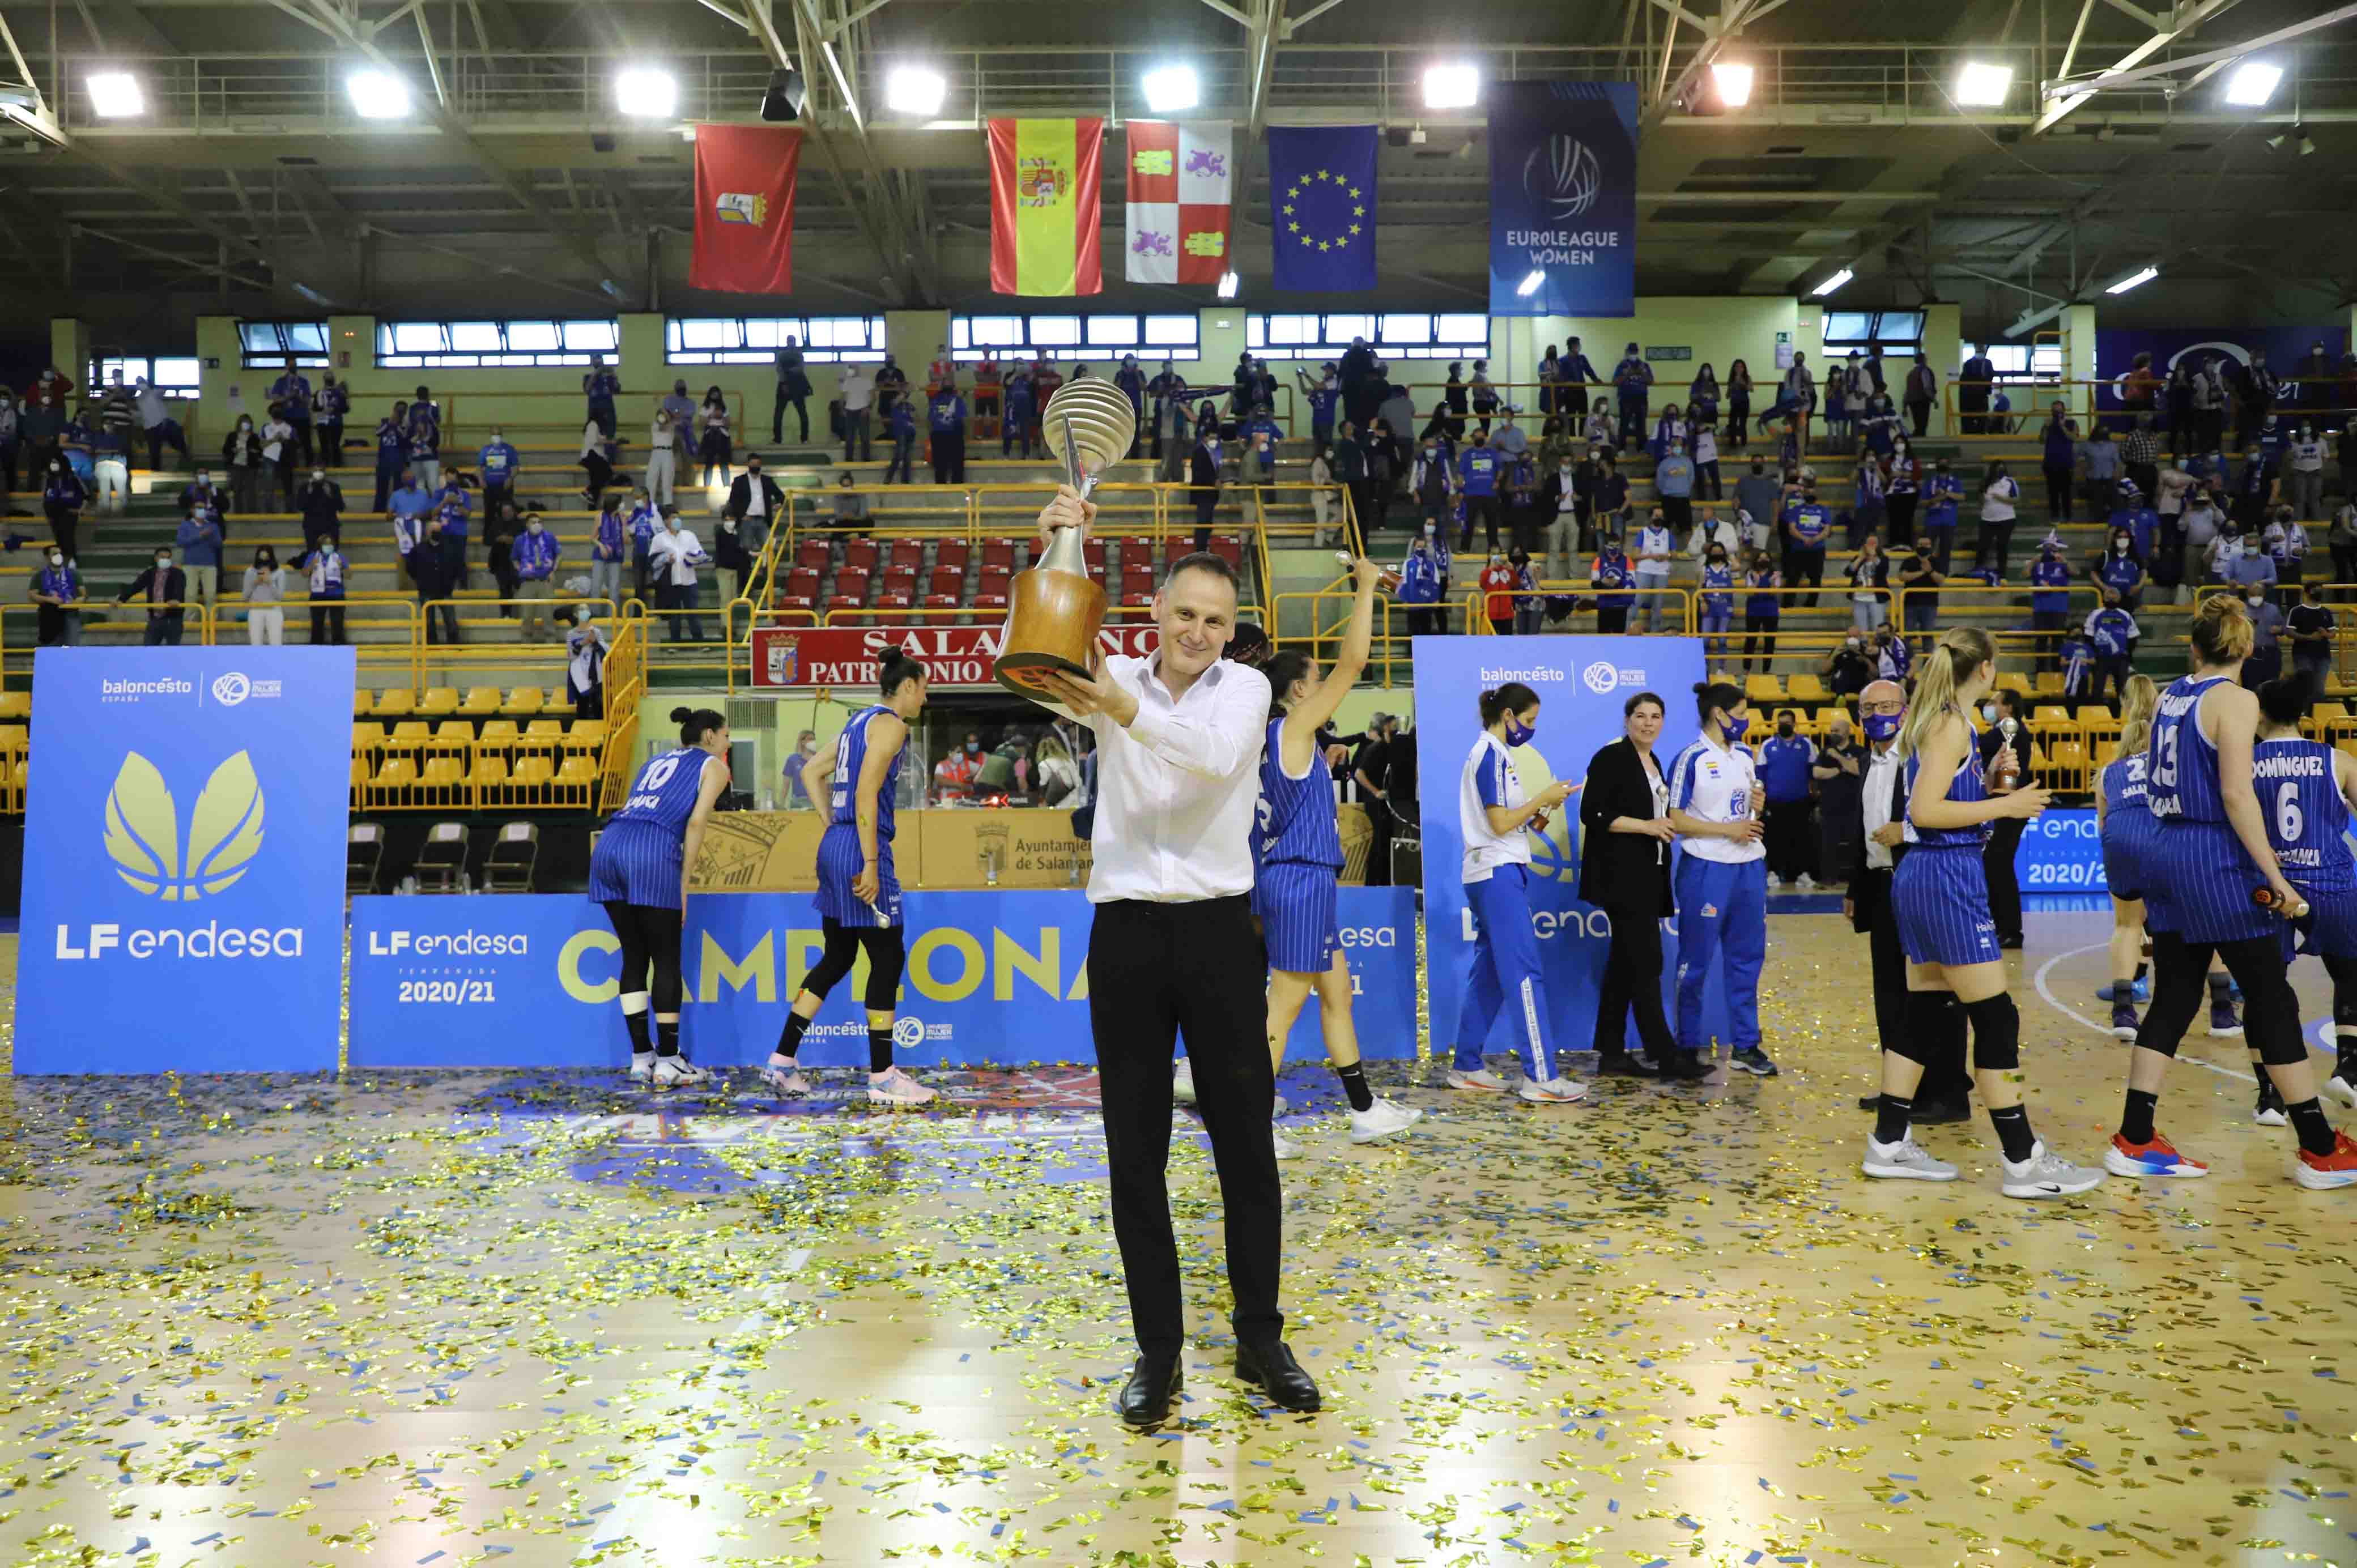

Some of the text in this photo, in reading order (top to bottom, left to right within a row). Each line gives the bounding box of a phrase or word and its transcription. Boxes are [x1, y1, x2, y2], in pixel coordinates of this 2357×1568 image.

[1507, 231, 1618, 246] EUROLEAGUE
[1530, 249, 1594, 265] WOMEN
[2277, 782, 2303, 842] 6
[1016, 857, 1031, 870] de
[2028, 860, 2108, 886] 2020/2
[57, 920, 303, 959] LF endesa
[369, 928, 527, 955] LF endesa
[398, 978, 496, 1005] 2020/21
